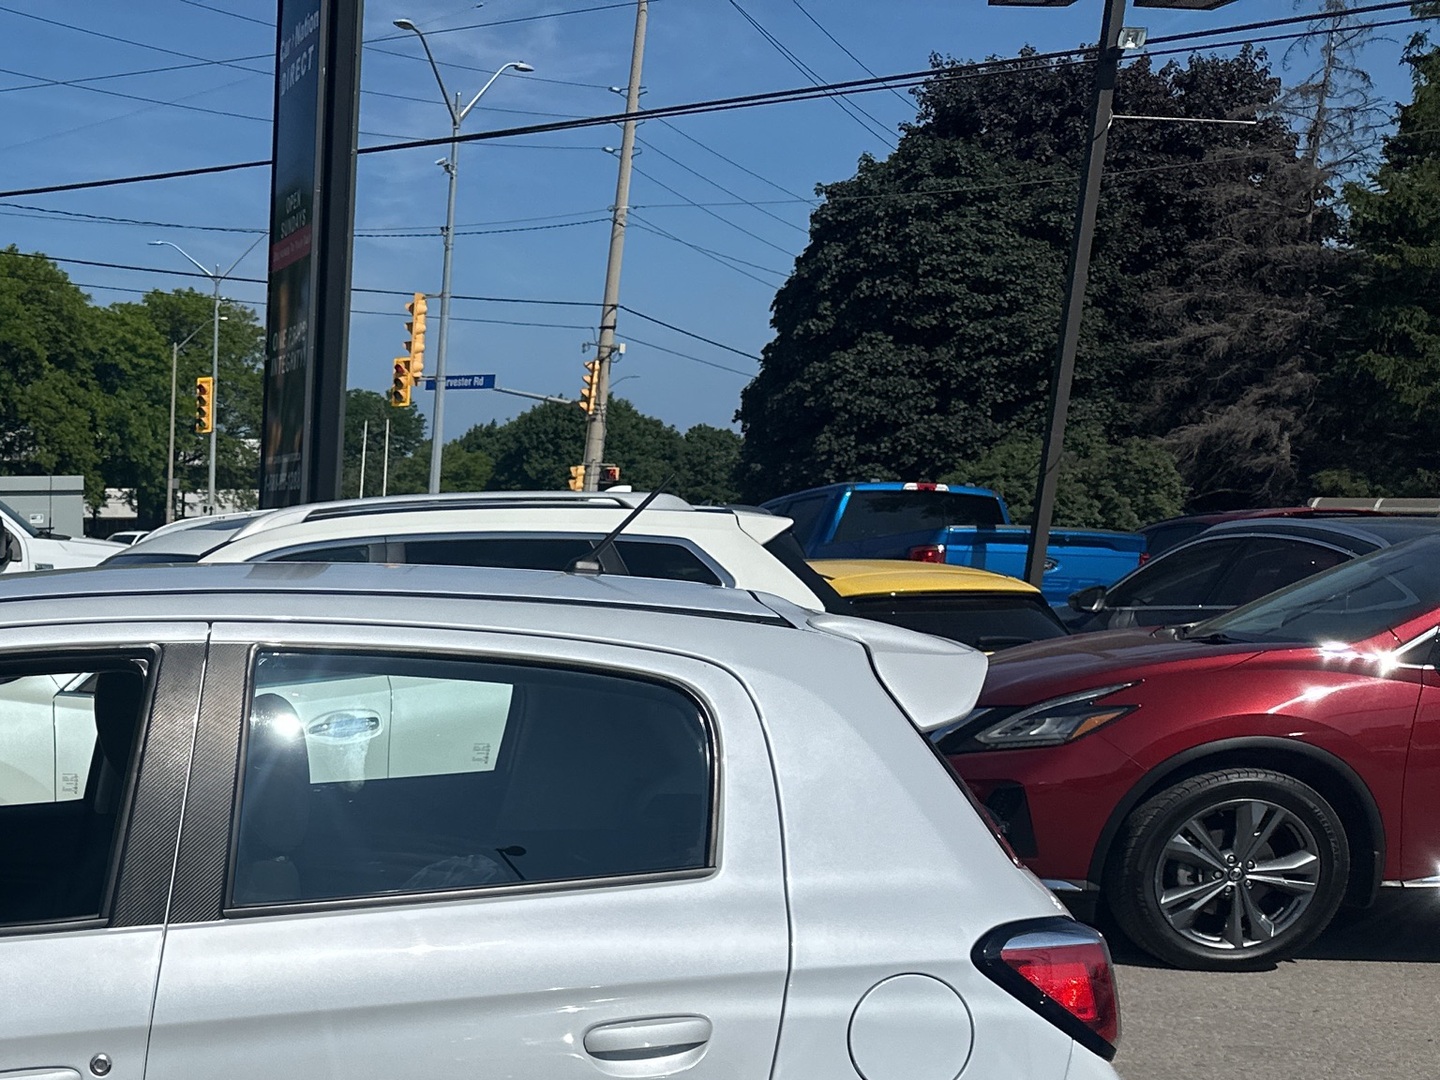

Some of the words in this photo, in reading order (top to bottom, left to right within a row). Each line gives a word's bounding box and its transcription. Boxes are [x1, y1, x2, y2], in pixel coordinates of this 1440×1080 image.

[295, 10, 319, 47] Nation
[281, 45, 314, 96] DIRECT
[444, 378, 472, 387] rvester
[473, 377, 484, 386] Rd
